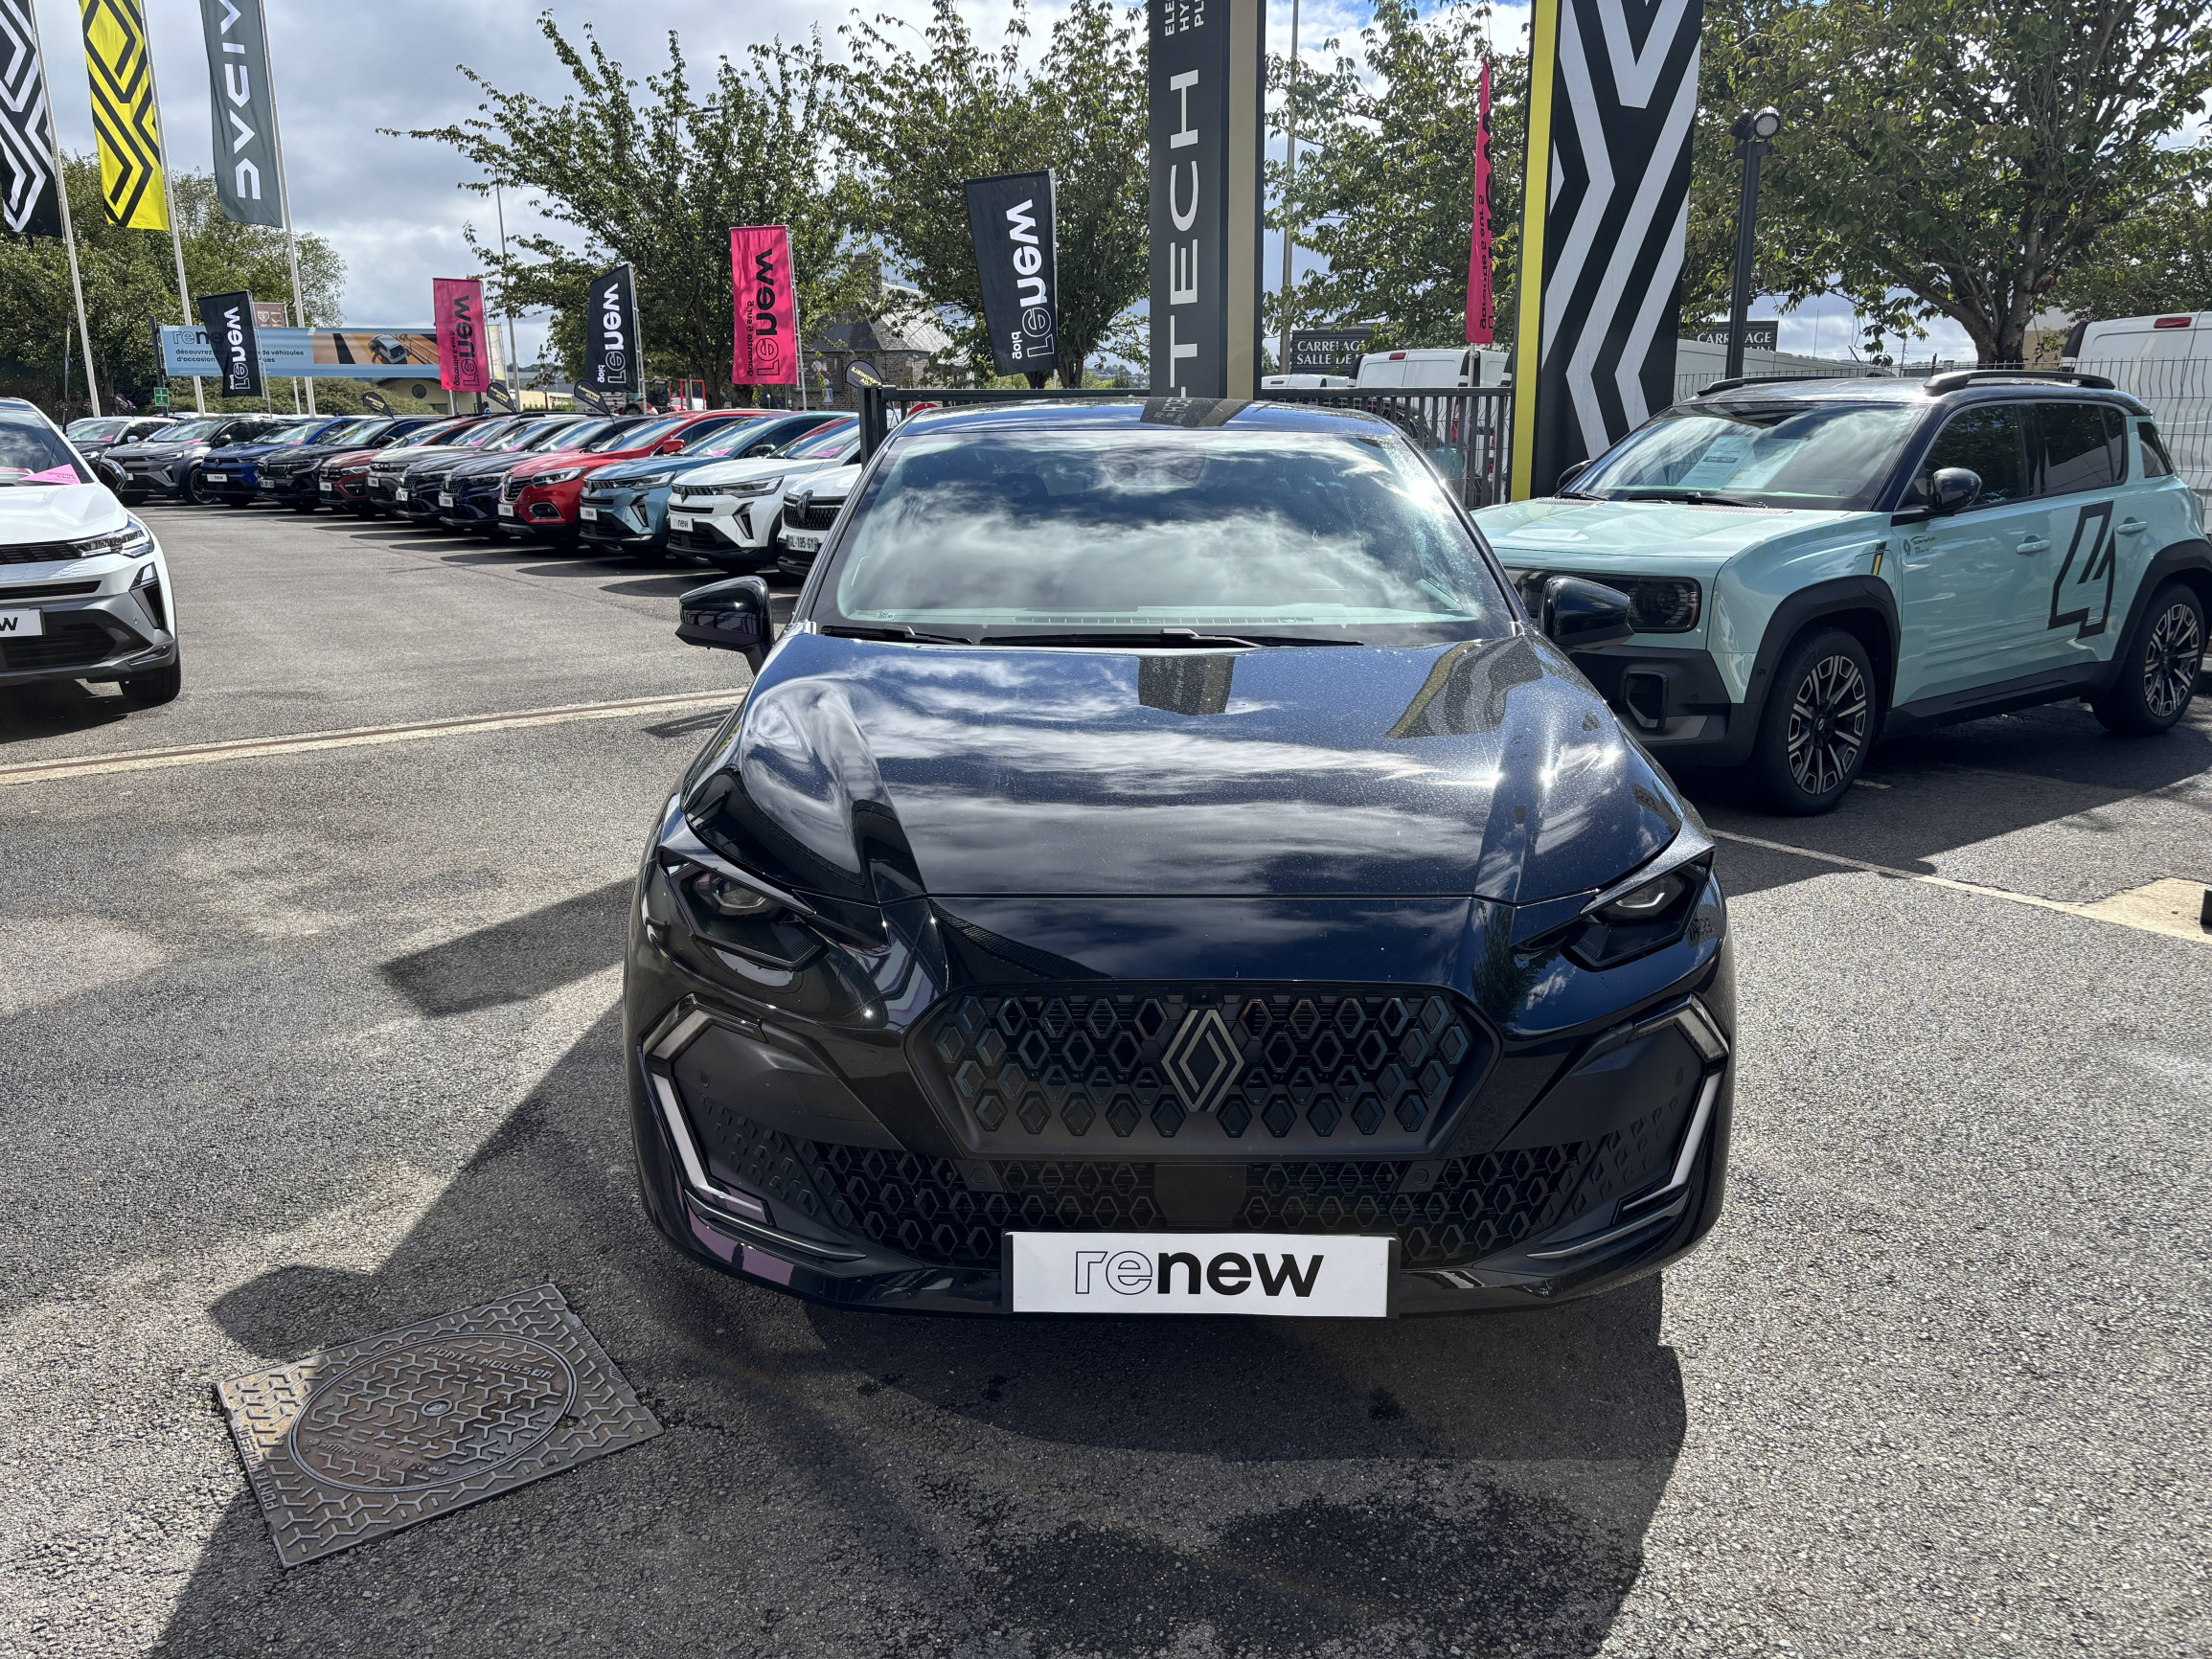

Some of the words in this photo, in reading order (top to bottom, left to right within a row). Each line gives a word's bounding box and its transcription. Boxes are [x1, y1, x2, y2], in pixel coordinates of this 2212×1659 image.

[1164, 0, 1175, 36] ELE
[1179, 0, 1190, 32] HY
[1194, 0, 1204, 28] PL
[172, 330, 225, 345] rene
[1297, 340, 1362, 352] CARREAG
[1697, 331, 1772, 345] CARRAGE
[1296, 353, 1332, 365] SALLE
[1075, 1250, 1325, 1297] renew
[479, 1357, 557, 1379] MOUSSON
